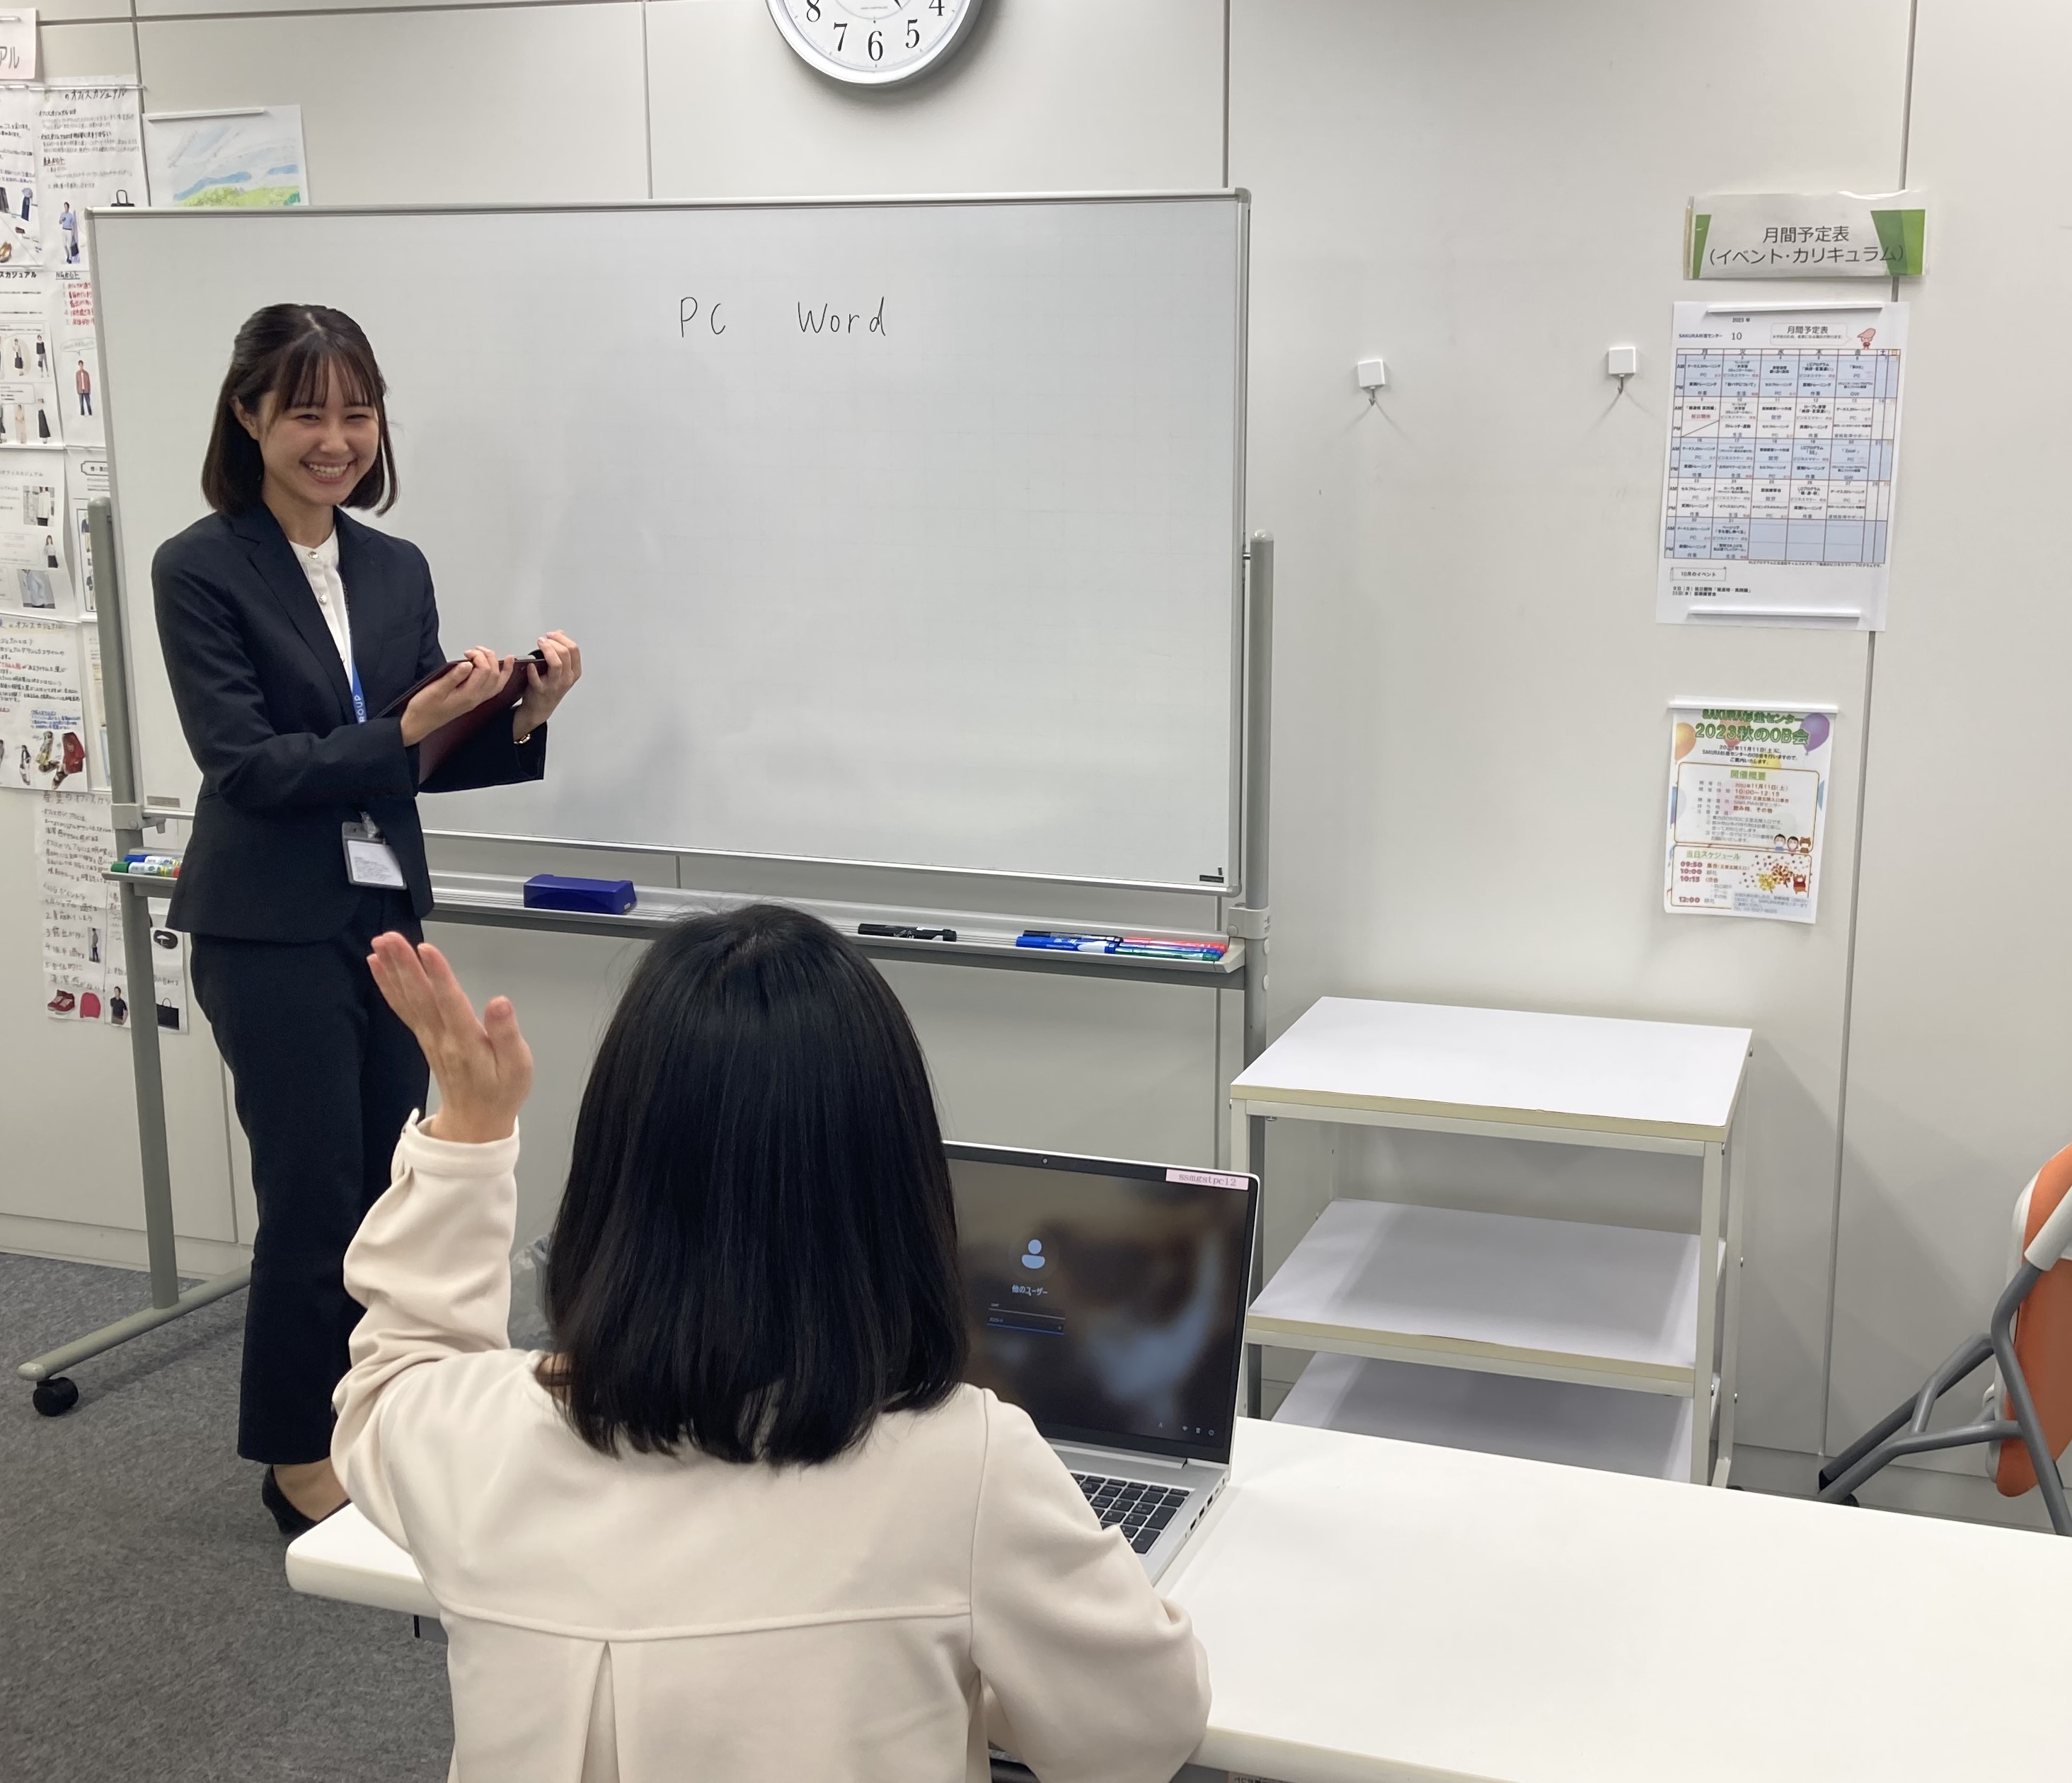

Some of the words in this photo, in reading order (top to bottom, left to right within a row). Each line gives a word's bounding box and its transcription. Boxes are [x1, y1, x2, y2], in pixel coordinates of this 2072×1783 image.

[834, 22, 848, 52] 7
[905, 19, 920, 48] 5
[868, 31, 883, 61] 6
[1763, 226, 1849, 243] 月間予定表
[681, 297, 725, 338] PC
[798, 297, 885, 336] Word
[1732, 332, 1742, 340] 10
[1702, 709, 1805, 724] SAKURA杉並センター
[1695, 723, 1809, 745] 2023秋のOB会
[1686, 850, 1741, 860] 当日スケジュール
[1012, 1284, 1048, 1297] 他のユーザー
